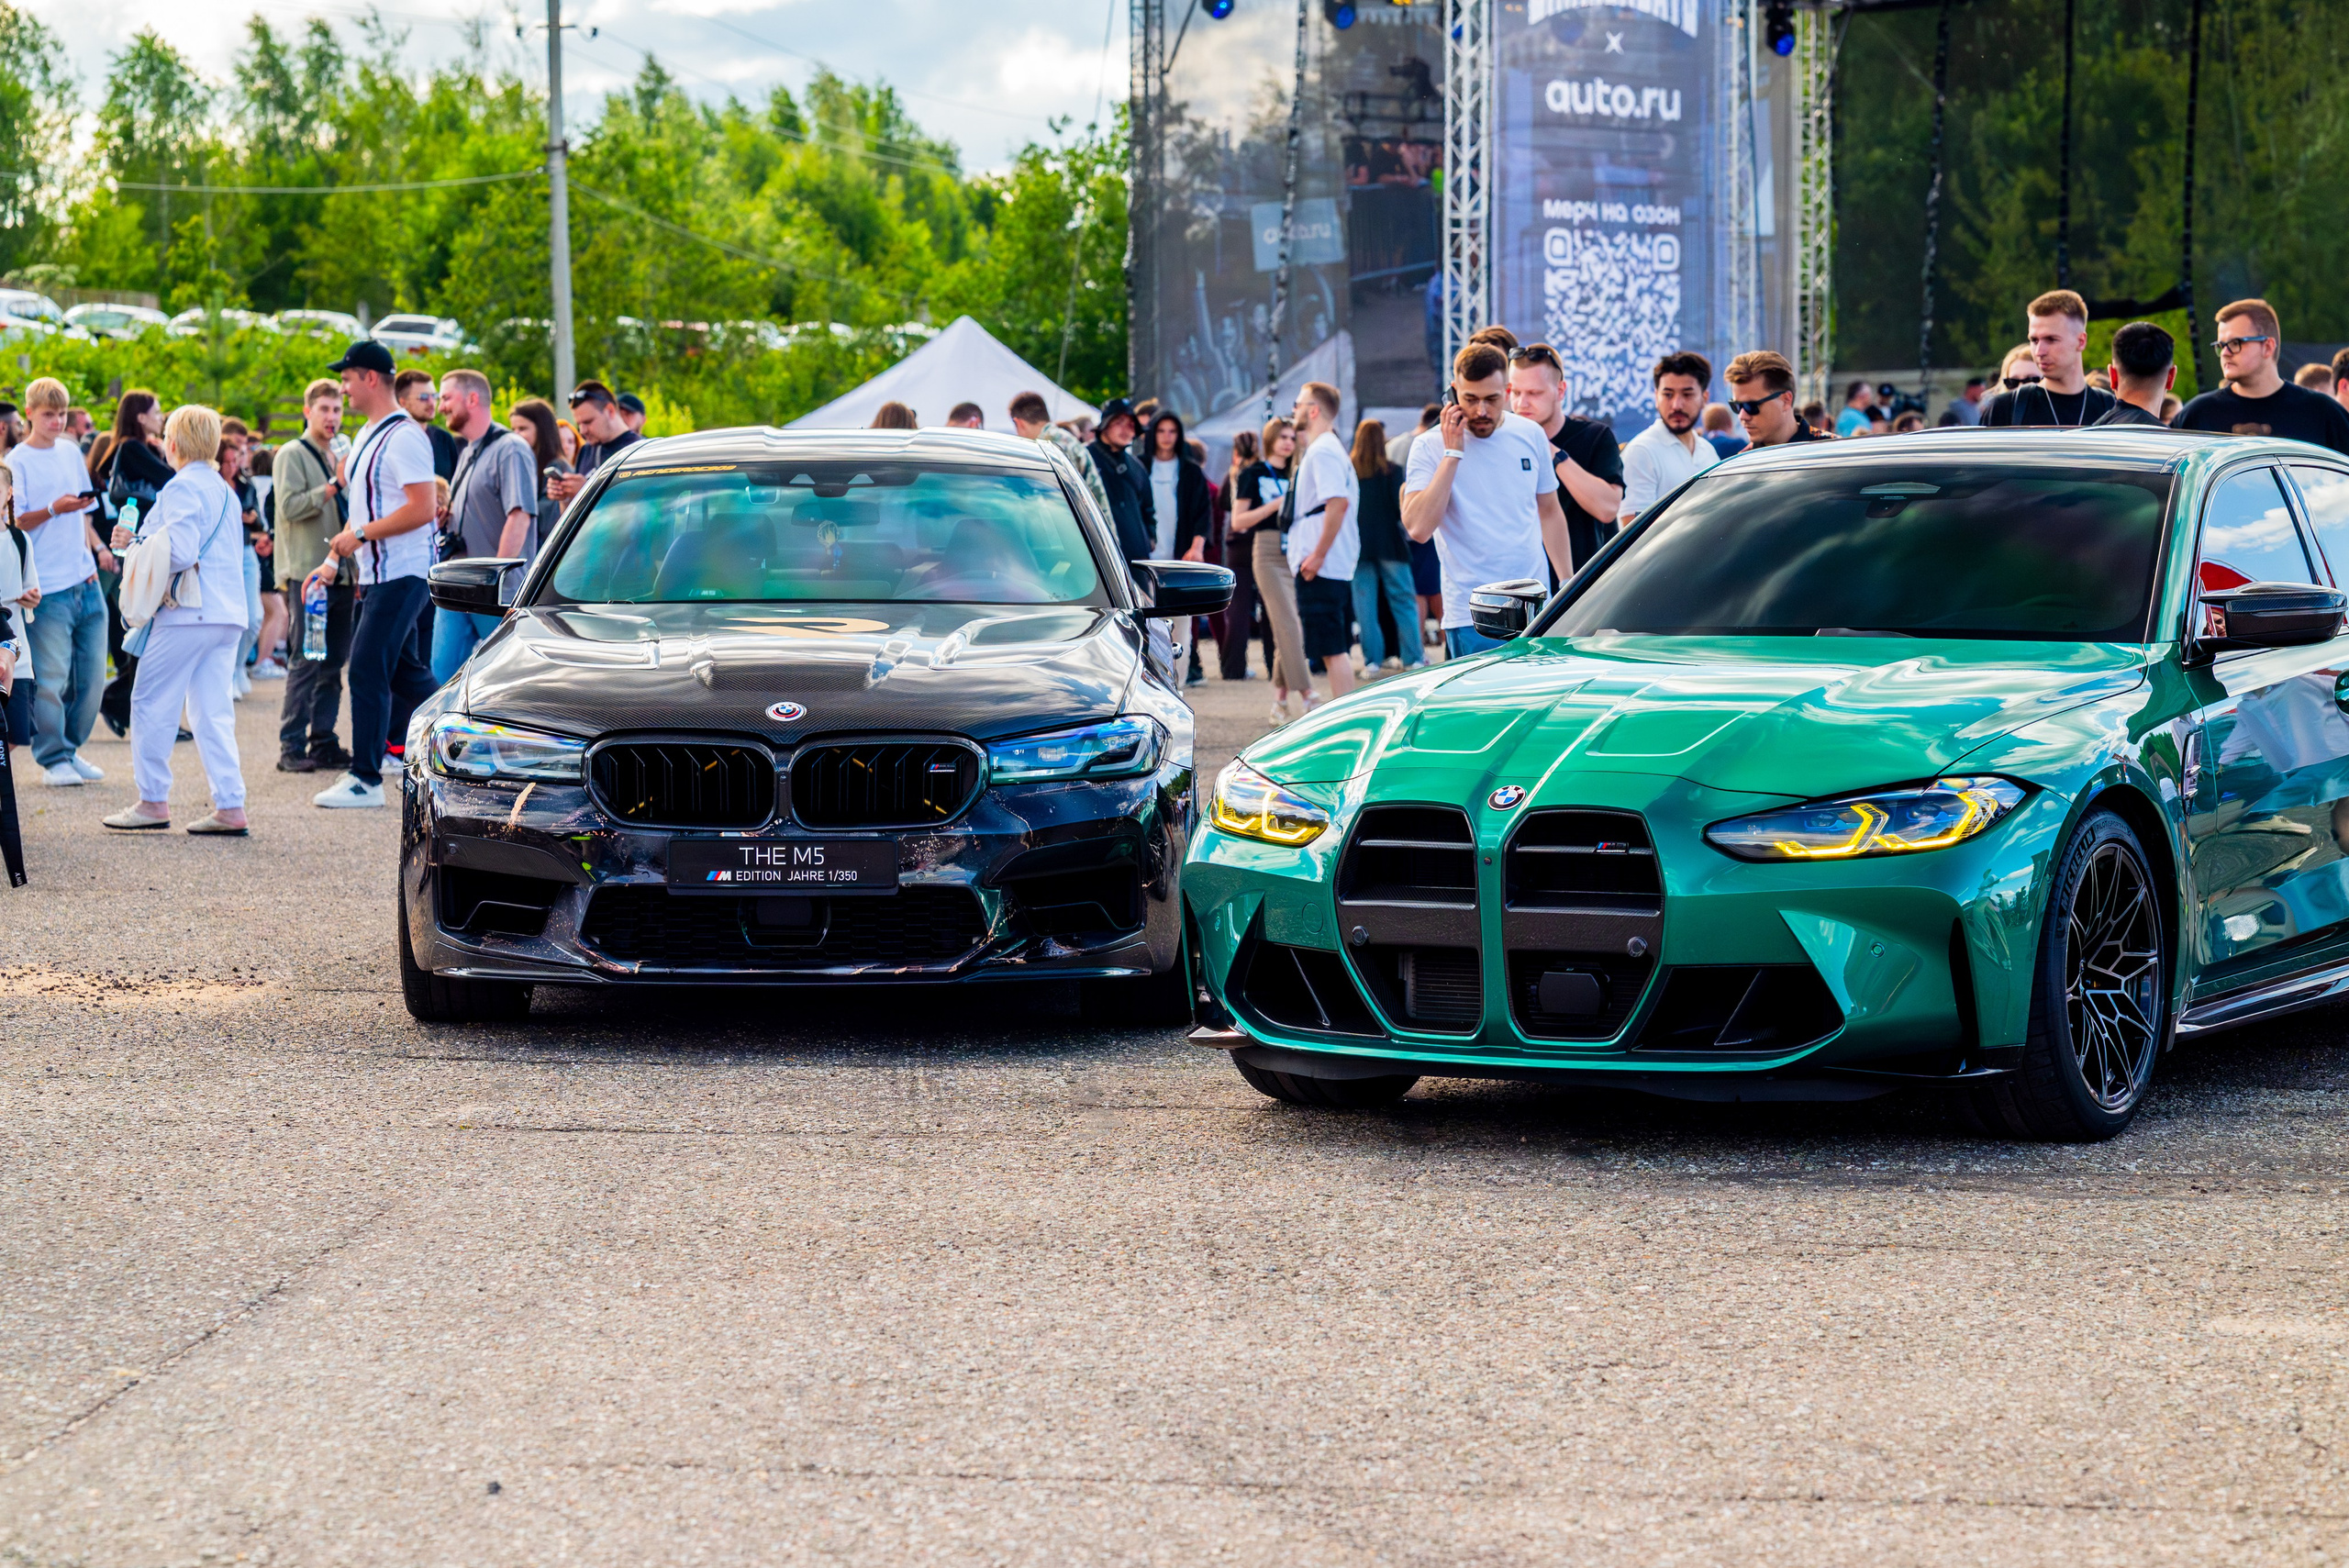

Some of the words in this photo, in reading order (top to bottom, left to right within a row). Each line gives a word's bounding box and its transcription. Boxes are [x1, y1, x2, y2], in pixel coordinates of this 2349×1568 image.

[1544, 76, 1682, 121] auto.ru
[1542, 198, 1598, 227] мерч
[1600, 202, 1629, 223] на
[1631, 204, 1681, 226] озон
[739, 847, 786, 865] THE
[794, 847, 825, 865] M5
[2060, 828, 2096, 912] MICHELIN
[736, 871, 781, 881] EDITION
[787, 871, 825, 881] JAHRE
[828, 871, 858, 882] 1/350
